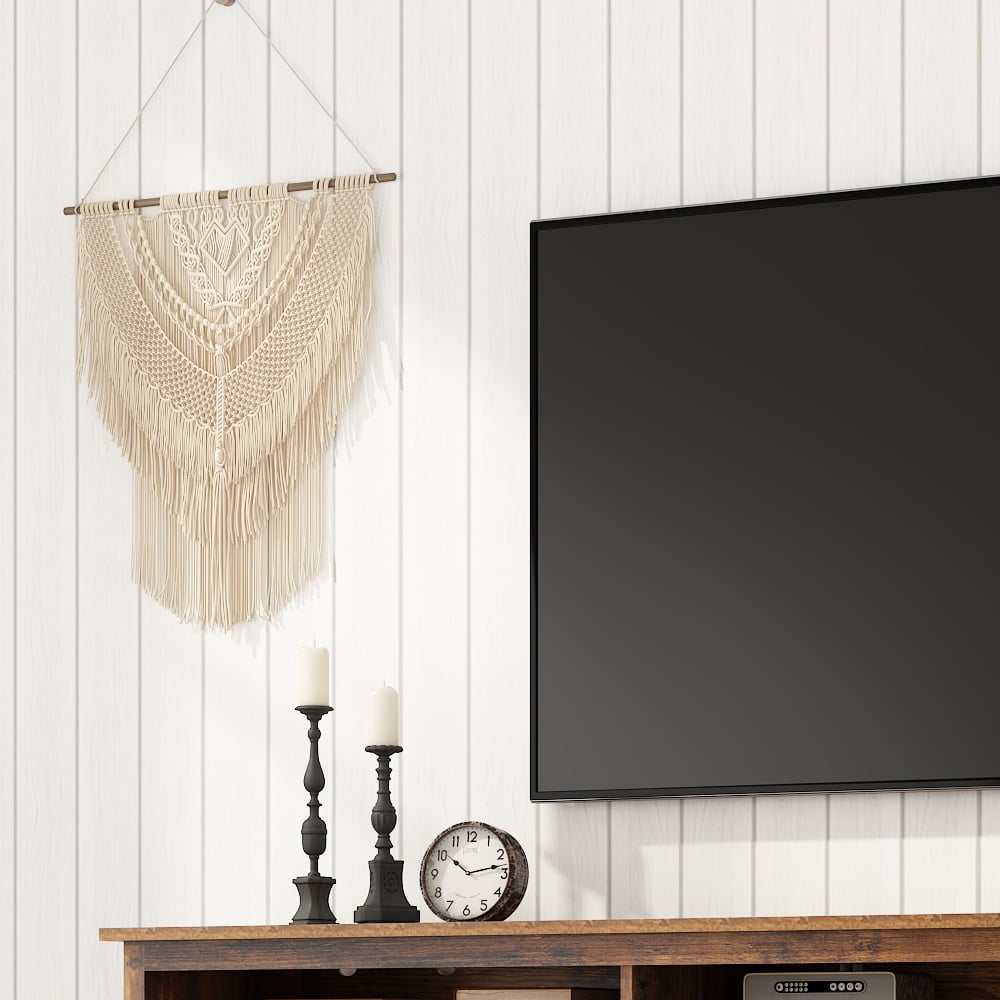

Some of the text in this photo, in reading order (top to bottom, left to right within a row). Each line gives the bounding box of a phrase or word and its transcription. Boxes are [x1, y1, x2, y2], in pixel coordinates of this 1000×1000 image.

[452, 836, 460, 848] 11
[467, 831, 478, 843] 12
[437, 849, 448, 862] 10
[497, 848, 505, 860] 2
[431, 868, 438, 880] 9
[500, 868, 508, 880] 3
[435, 887, 442, 898] 8
[493, 887, 502, 898] 4
[446, 900, 454, 912] 7
[462, 904, 471, 916] 6
[480, 899, 488, 912] 5
